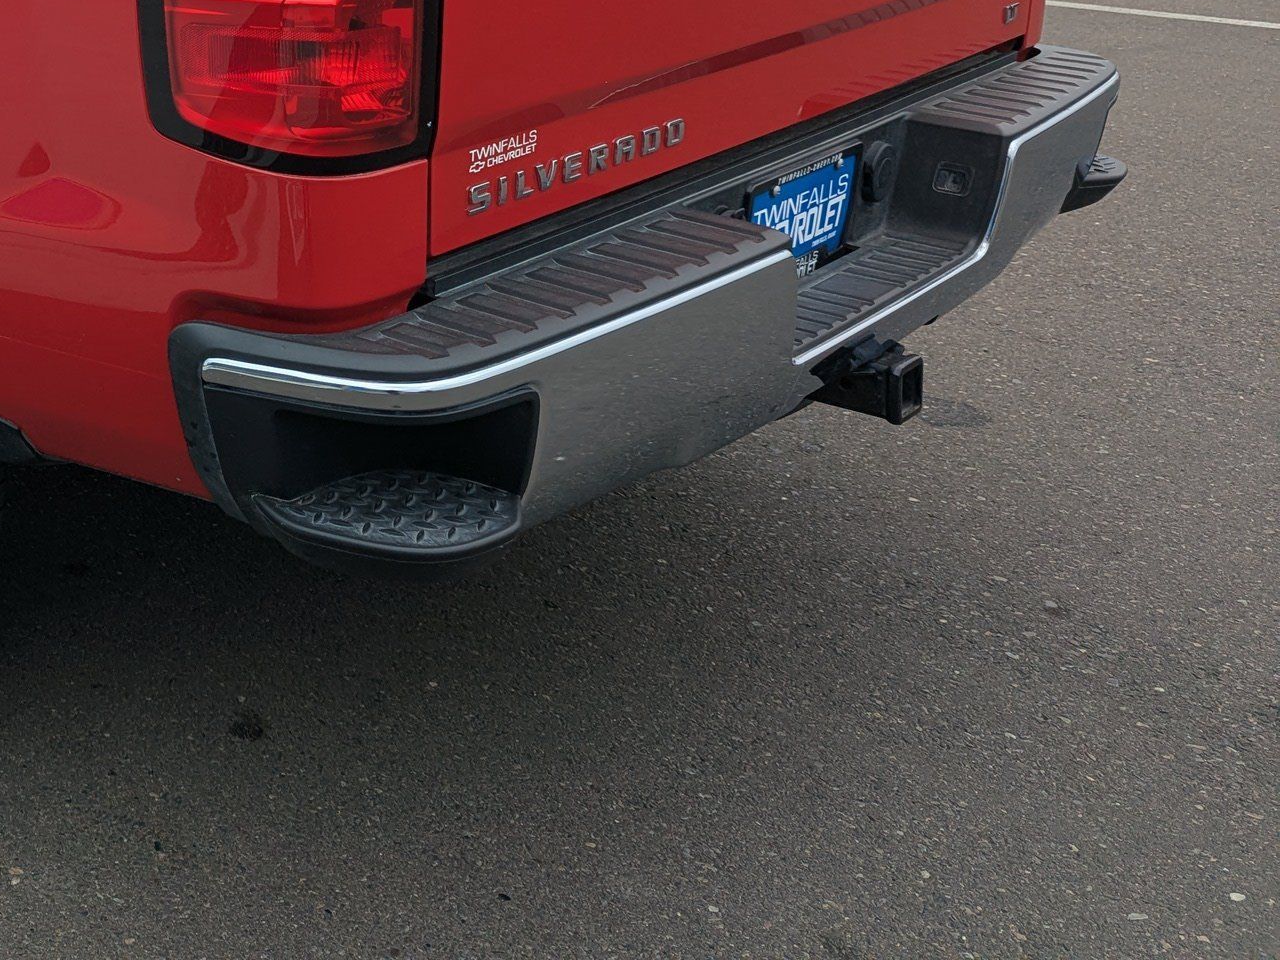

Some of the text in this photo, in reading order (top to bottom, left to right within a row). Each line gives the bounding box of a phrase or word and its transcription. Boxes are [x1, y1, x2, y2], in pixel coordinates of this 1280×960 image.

[467, 118, 685, 216] SILVERADO
[469, 129, 537, 162] TWINFALLS
[487, 143, 537, 168] CHEVROLET
[754, 173, 848, 228] TWINFALLS
